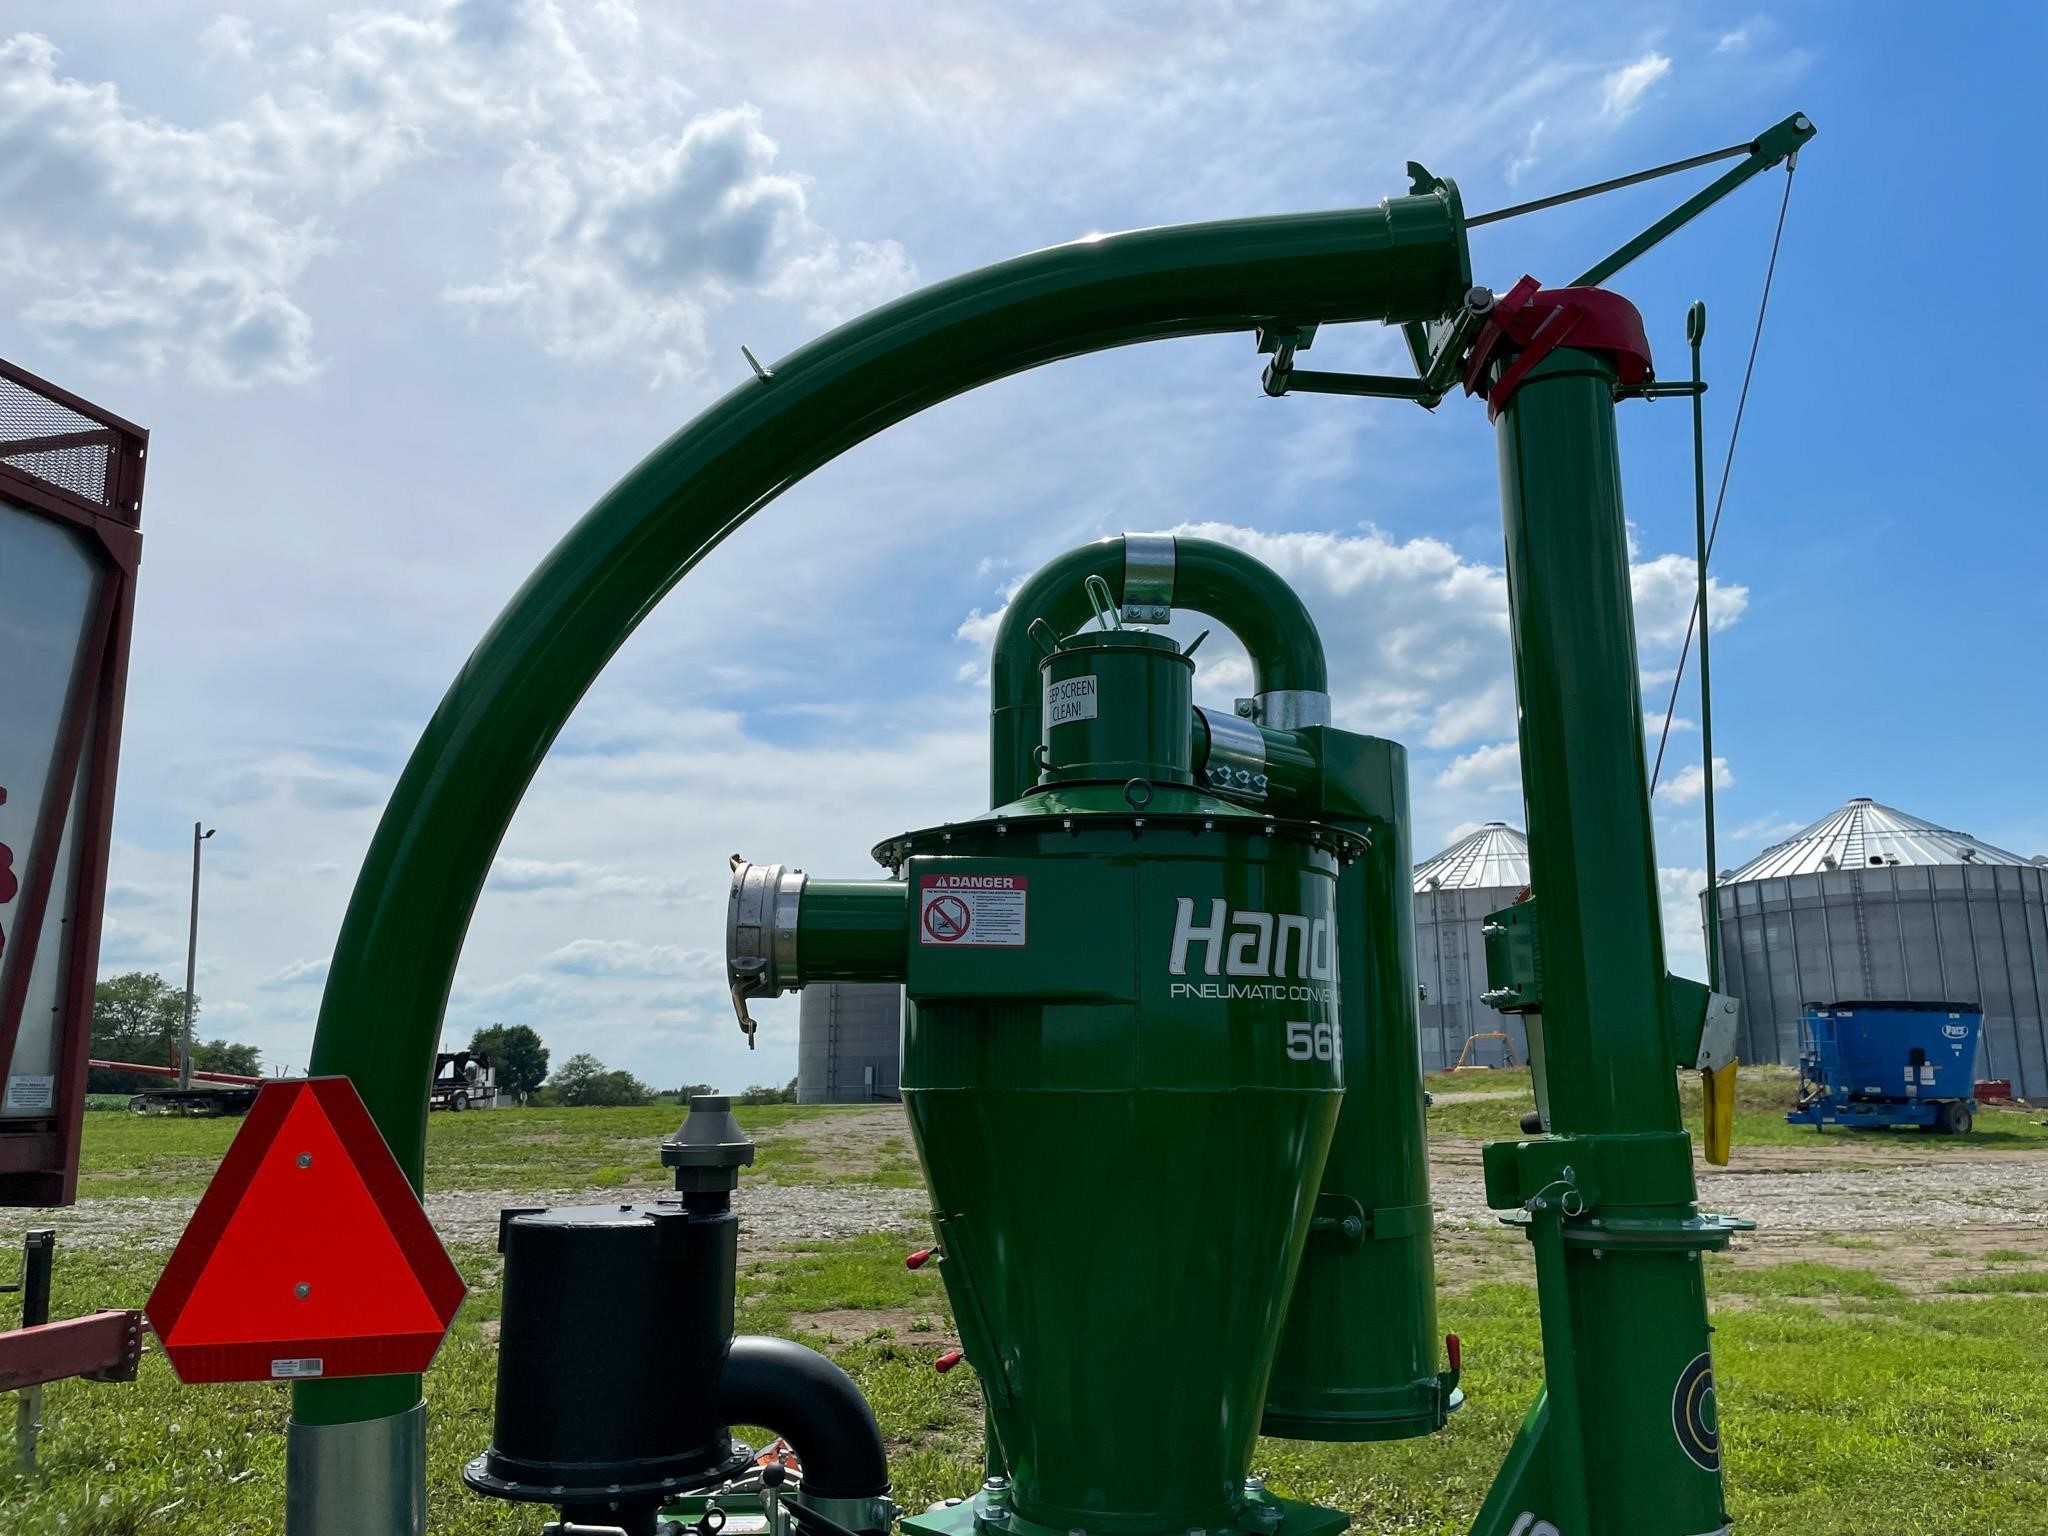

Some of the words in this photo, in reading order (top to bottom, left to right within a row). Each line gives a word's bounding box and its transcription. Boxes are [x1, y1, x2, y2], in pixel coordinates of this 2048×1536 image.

[1061, 680, 1095, 700] SCREEN
[1052, 701, 1082, 722] CLEAN!
[949, 876, 1014, 888] DANGER
[1170, 983, 1286, 1000] PNEUMATIC
